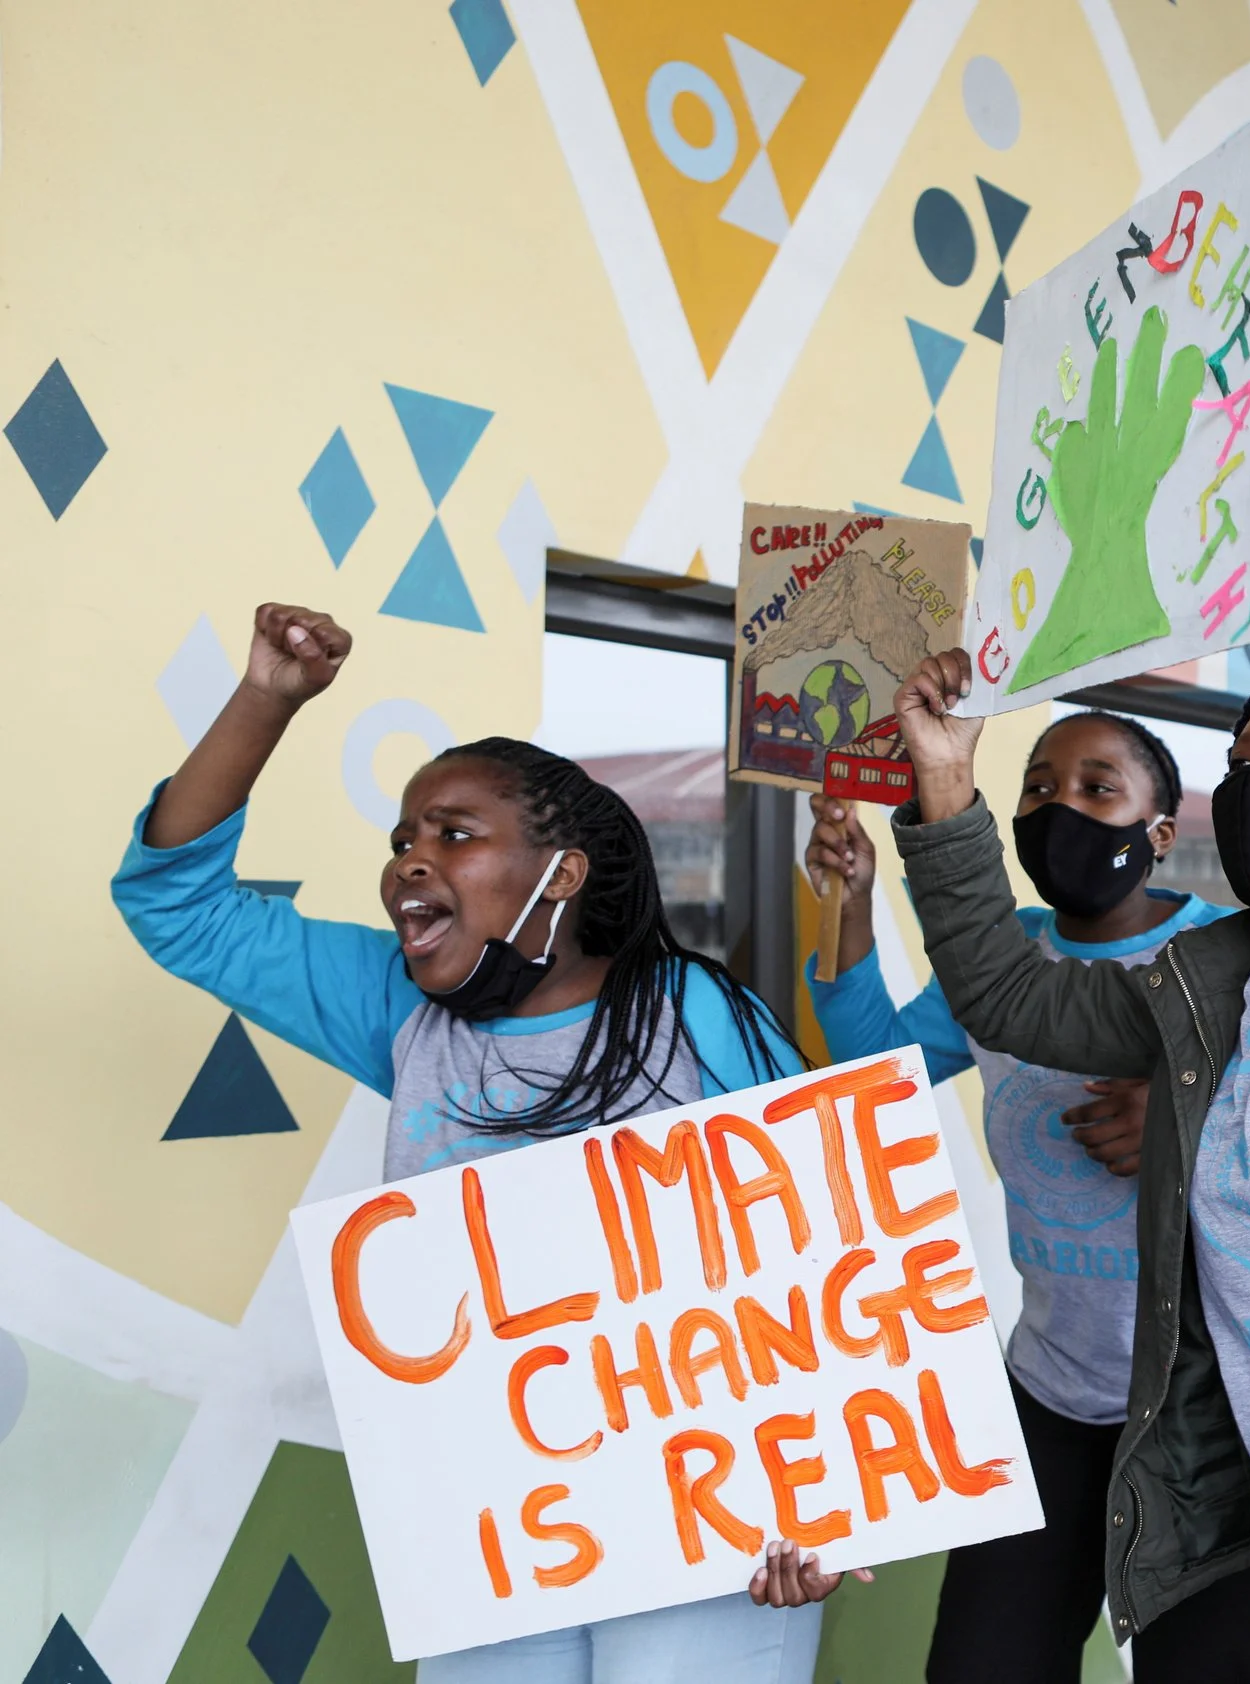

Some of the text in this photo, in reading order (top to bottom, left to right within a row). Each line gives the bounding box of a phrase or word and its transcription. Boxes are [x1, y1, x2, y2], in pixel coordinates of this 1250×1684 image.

[1112, 852, 1129, 869] EY
[331, 1056, 960, 1385] CLIMATE
[508, 1238, 990, 1461] CHANGE
[479, 1369, 1019, 1599] IS REAL
